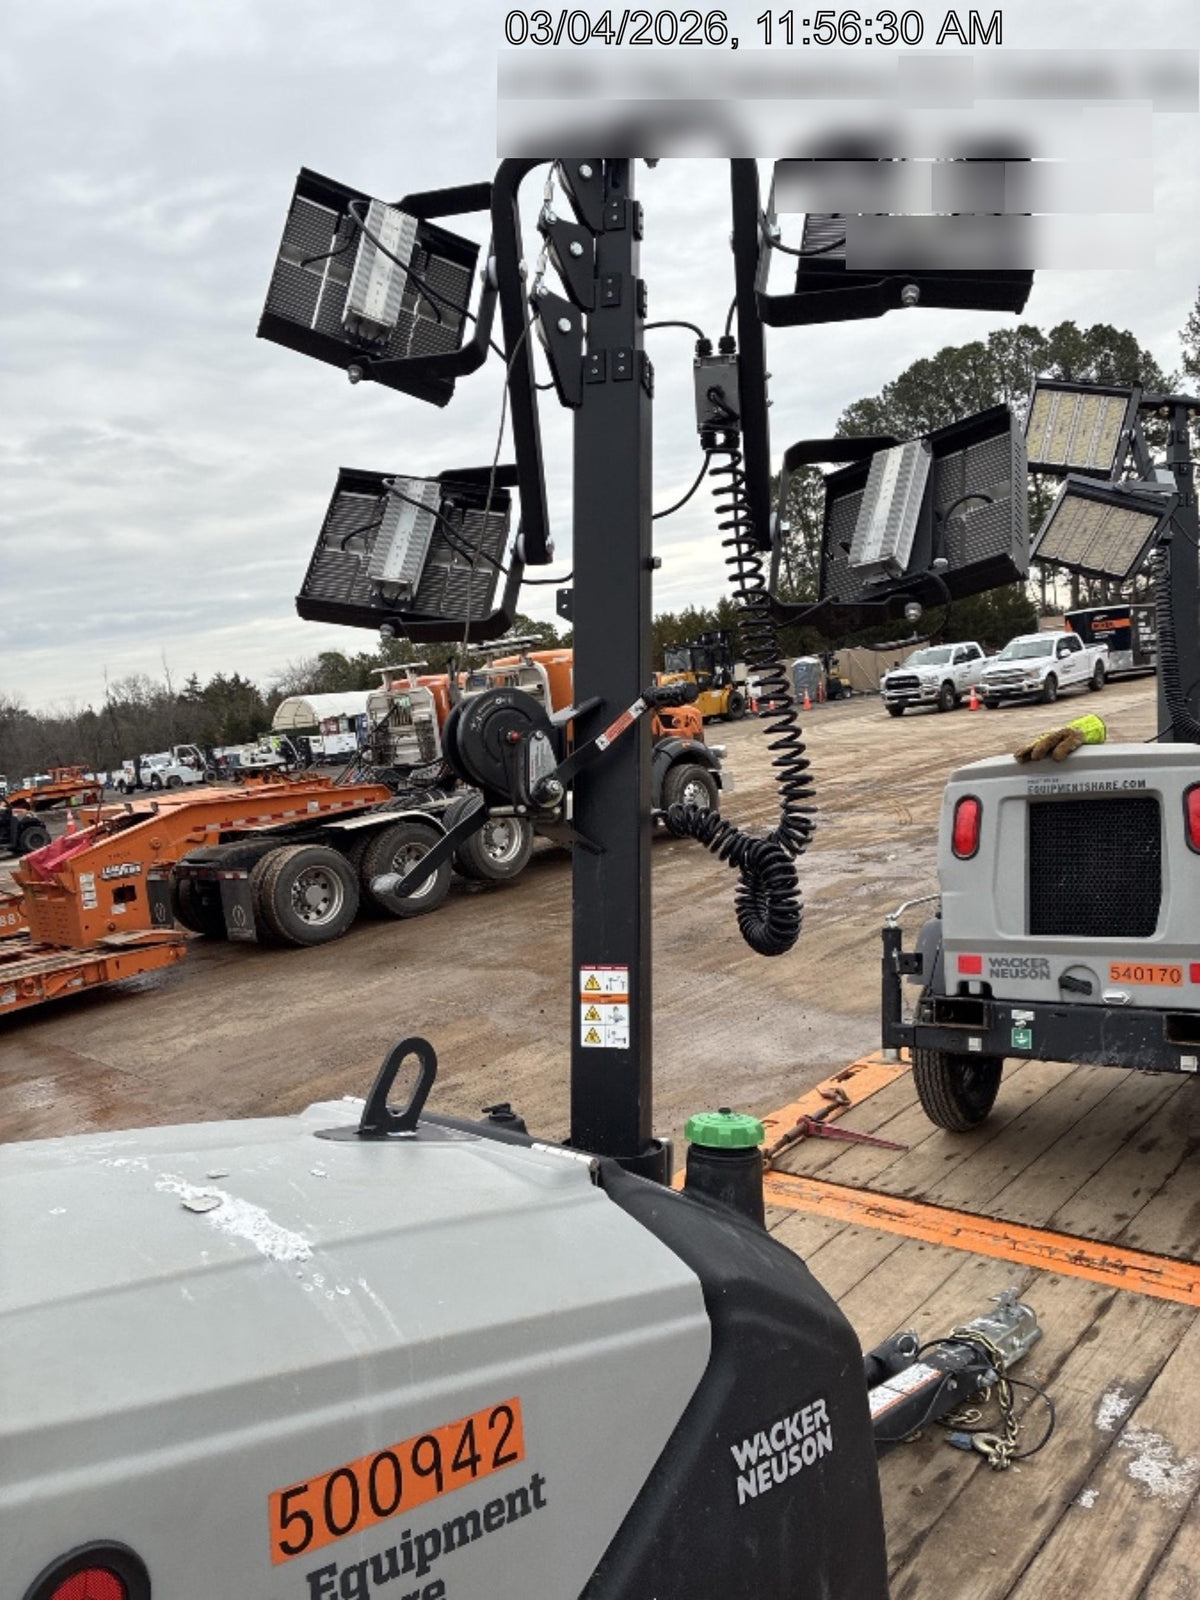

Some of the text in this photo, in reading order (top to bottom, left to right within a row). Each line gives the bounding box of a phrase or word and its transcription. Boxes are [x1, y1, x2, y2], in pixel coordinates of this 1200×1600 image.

[988, 957, 1050, 969] WACKER
[989, 968, 1051, 980] NEUSON
[1109, 966, 1183, 984] 540170
[730, 1398, 830, 1472] WACKER
[736, 1424, 833, 1506] NEUSON
[278, 1404, 519, 1556] 500942
[306, 1472, 547, 1600] Equipment
